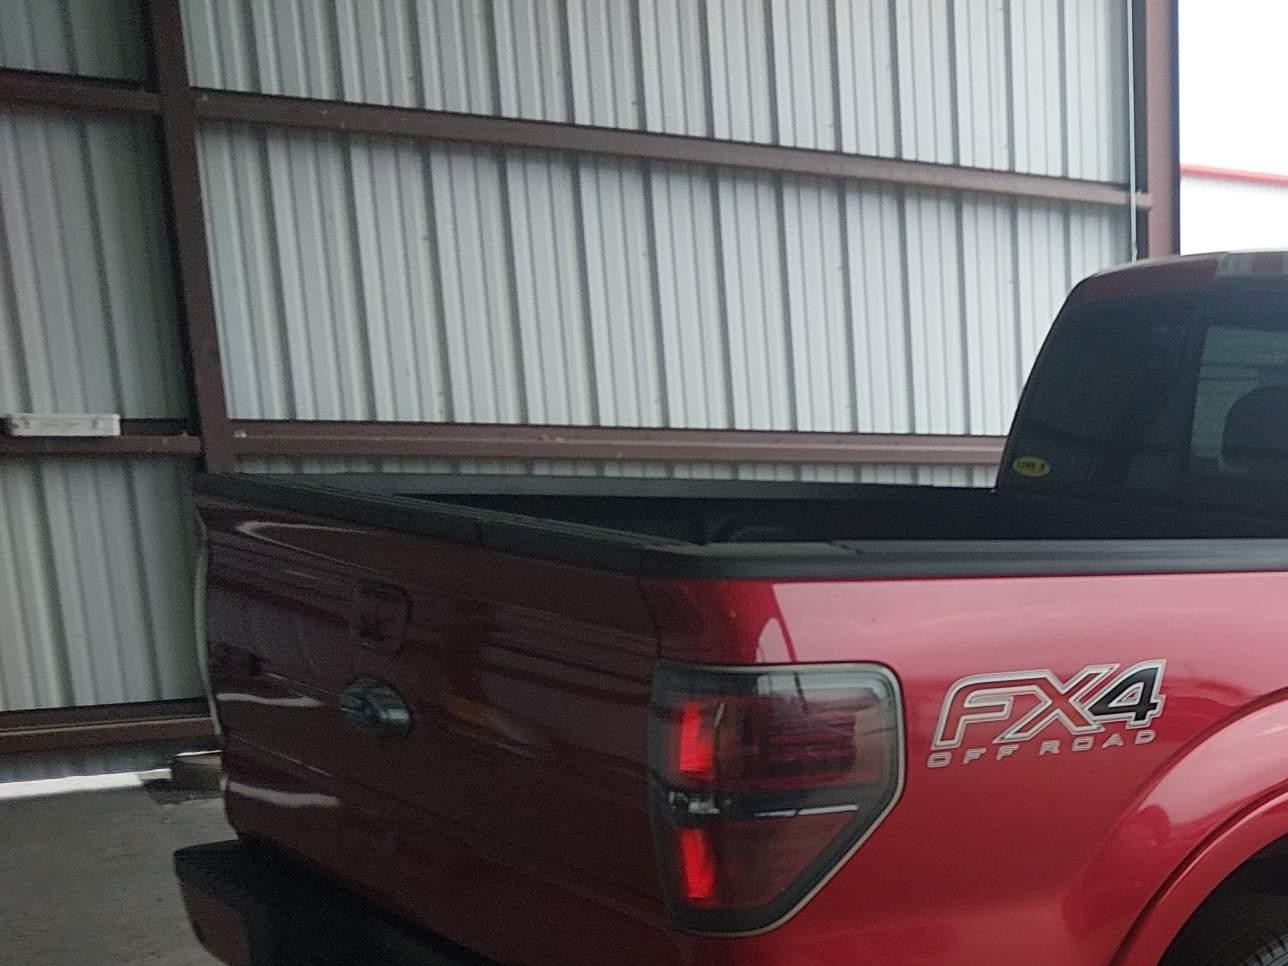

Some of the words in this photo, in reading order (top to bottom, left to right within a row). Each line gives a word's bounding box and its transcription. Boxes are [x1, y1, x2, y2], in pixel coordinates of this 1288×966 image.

[931, 659, 1167, 750] FX4
[927, 743, 1019, 768] OFF
[1040, 730, 1156, 756] ROAD
